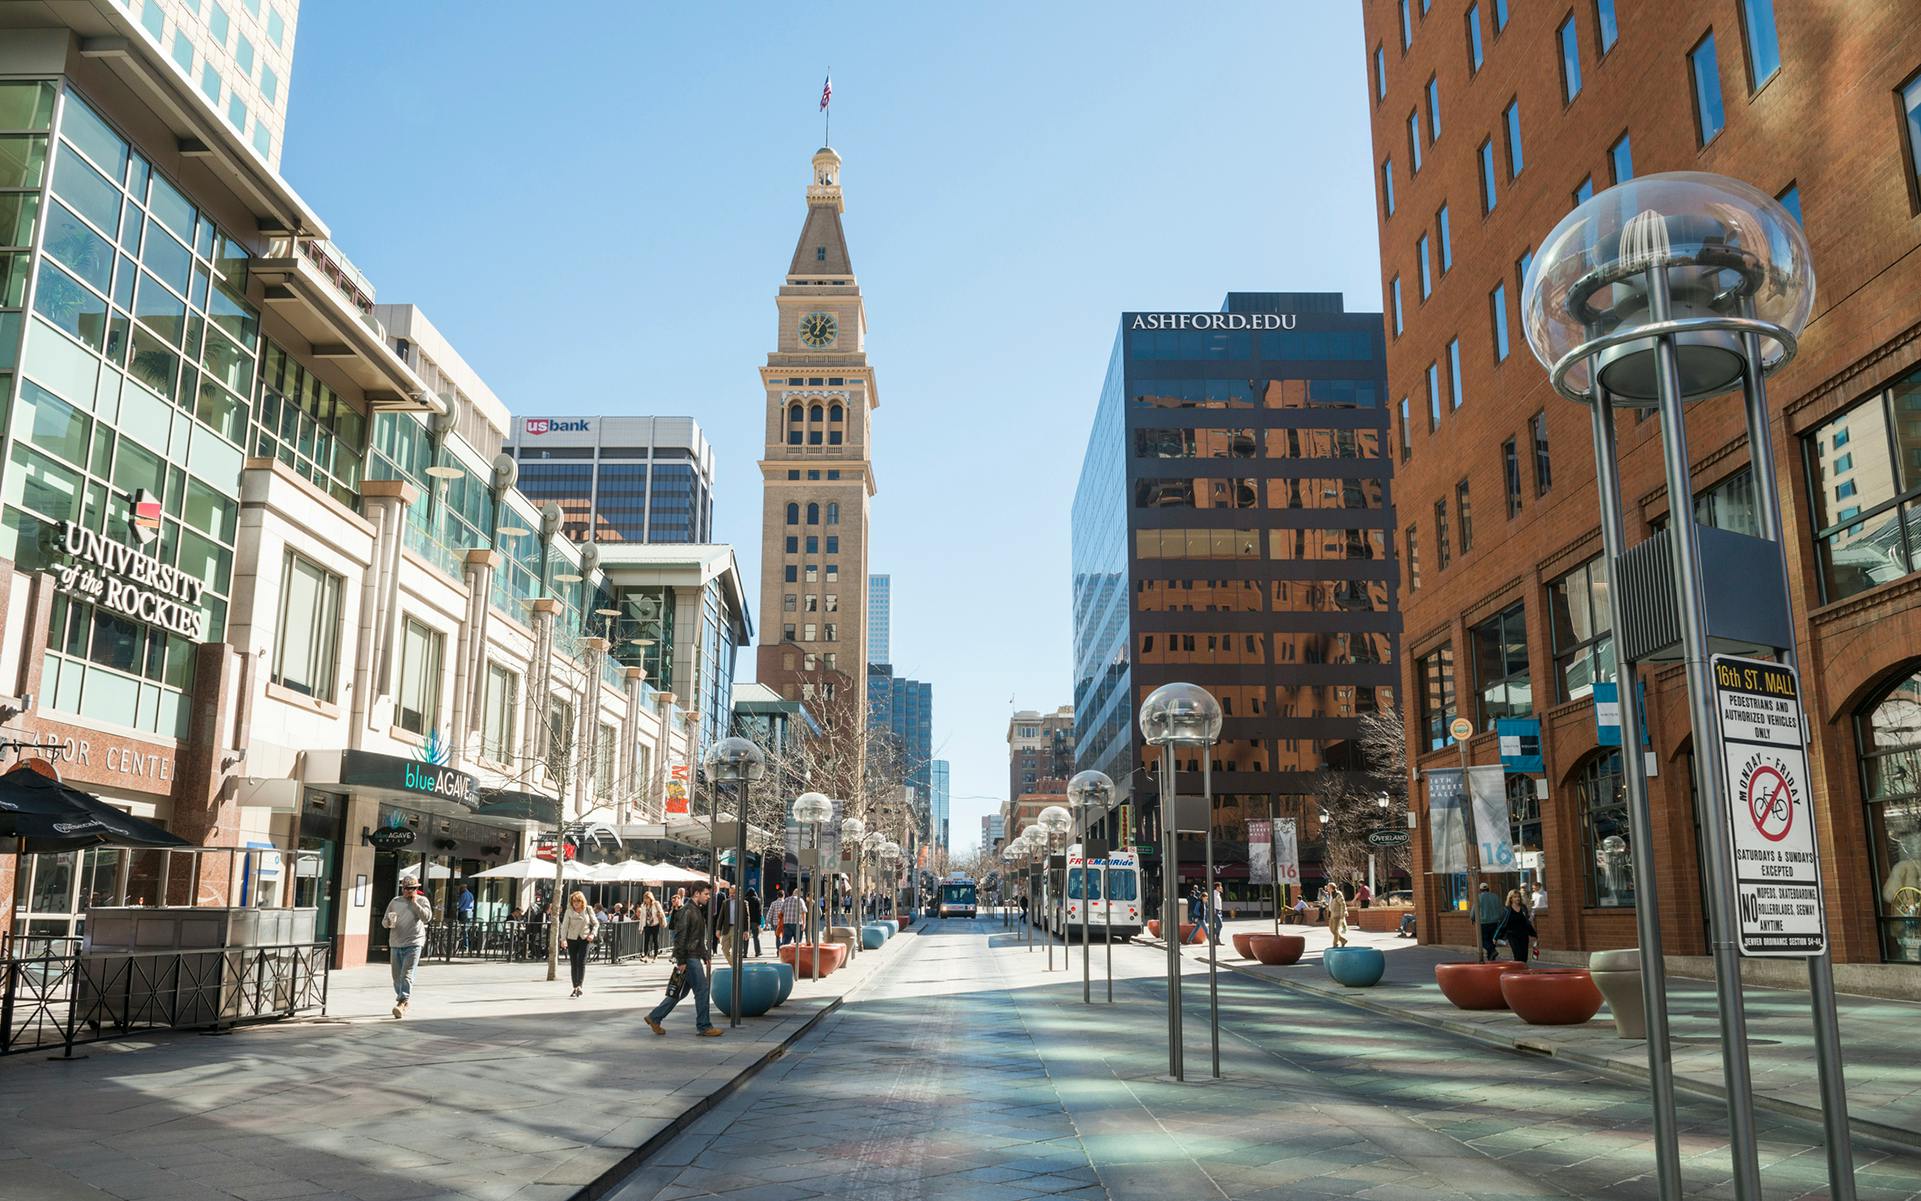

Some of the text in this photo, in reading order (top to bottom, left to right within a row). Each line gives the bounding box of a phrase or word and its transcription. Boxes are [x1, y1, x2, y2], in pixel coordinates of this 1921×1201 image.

[1132, 314, 1297, 330] ASHFORD.EDU
[65, 520, 206, 606] UNIVERSITY
[61, 564, 201, 638] of the ROCKIES
[1716, 664, 1796, 695] 16th ST. MALL
[1729, 694, 1789, 713] PEDESTRIANS AND
[1725, 709, 1797, 728] AUTHORIZED VEHICLES
[1755, 727, 1771, 739] ONLY
[32, 731, 91, 766] ABOR
[1739, 752, 1762, 802] MONDAY
[1775, 758, 1801, 805] FRIDAY
[1371, 833, 1408, 842] OVERLAND
[1482, 840, 1513, 866] 16
[1737, 848, 1814, 864] SATURDAYS & SUNDAYS
[1280, 863, 1297, 879] 16
[1761, 865, 1794, 877] EXCEPTED
[1742, 893, 1758, 923] NO
[1796, 904, 1815, 915] SEGWAY
[1760, 919, 1783, 931] ANYTIME
[1789, 937, 1807, 946] SECTION
